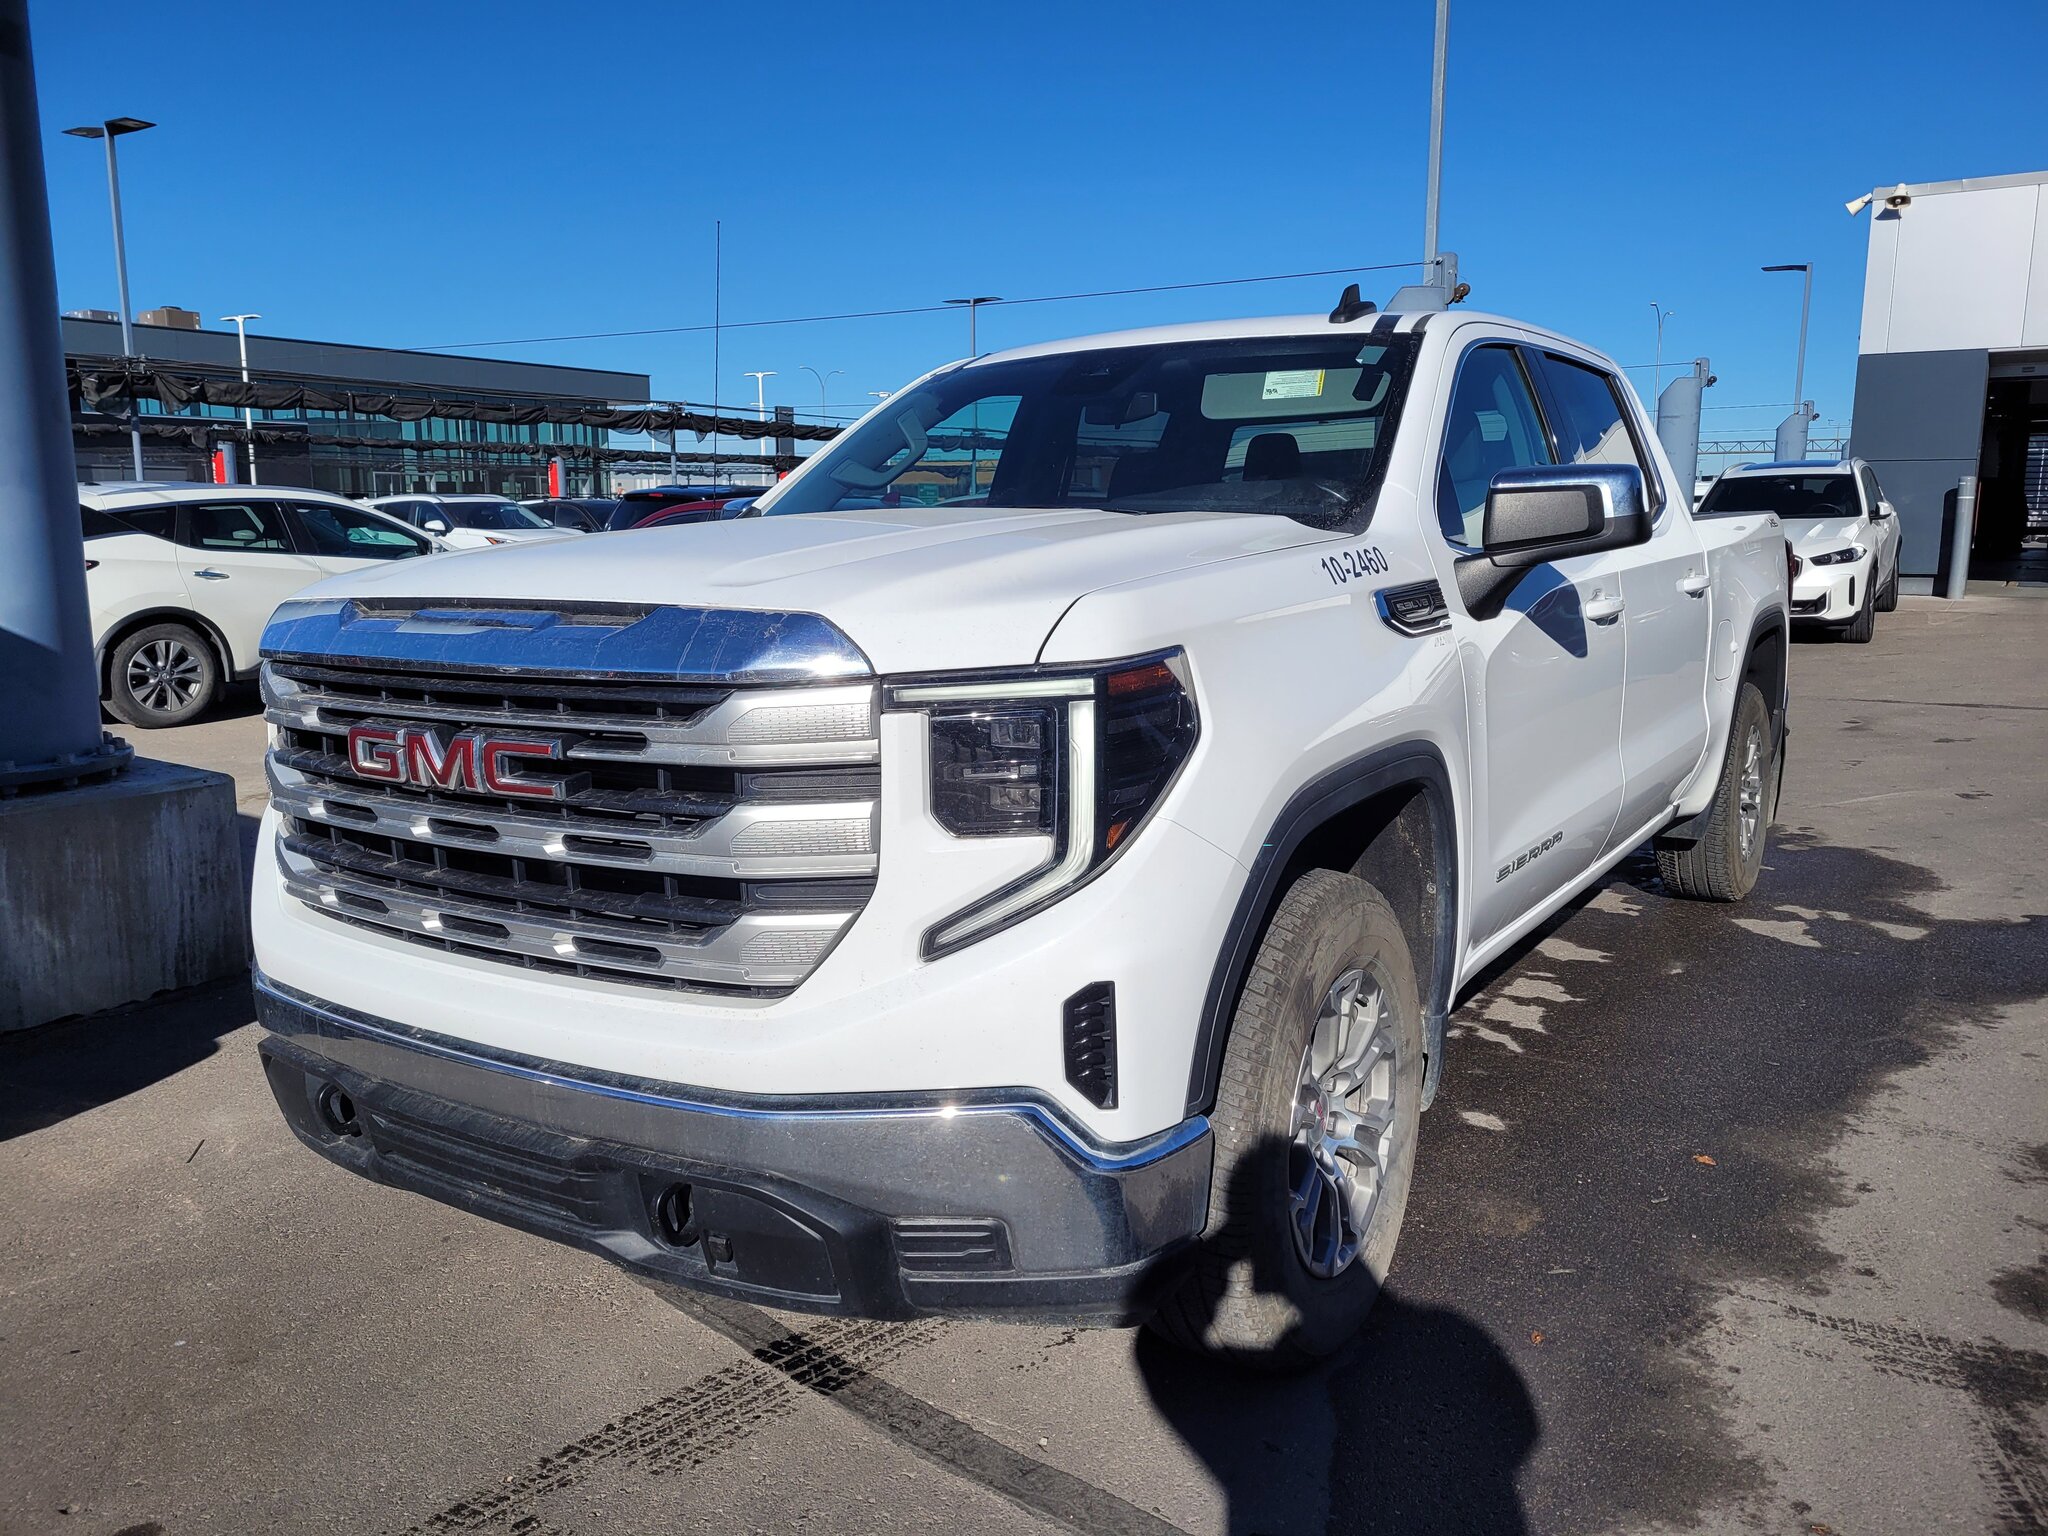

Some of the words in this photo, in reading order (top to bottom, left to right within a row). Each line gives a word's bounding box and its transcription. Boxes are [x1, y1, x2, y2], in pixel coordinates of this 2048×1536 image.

[1321, 546, 1389, 585] 10-2460
[348, 724, 568, 800] GMC
[1495, 830, 1564, 884] SIERRA
